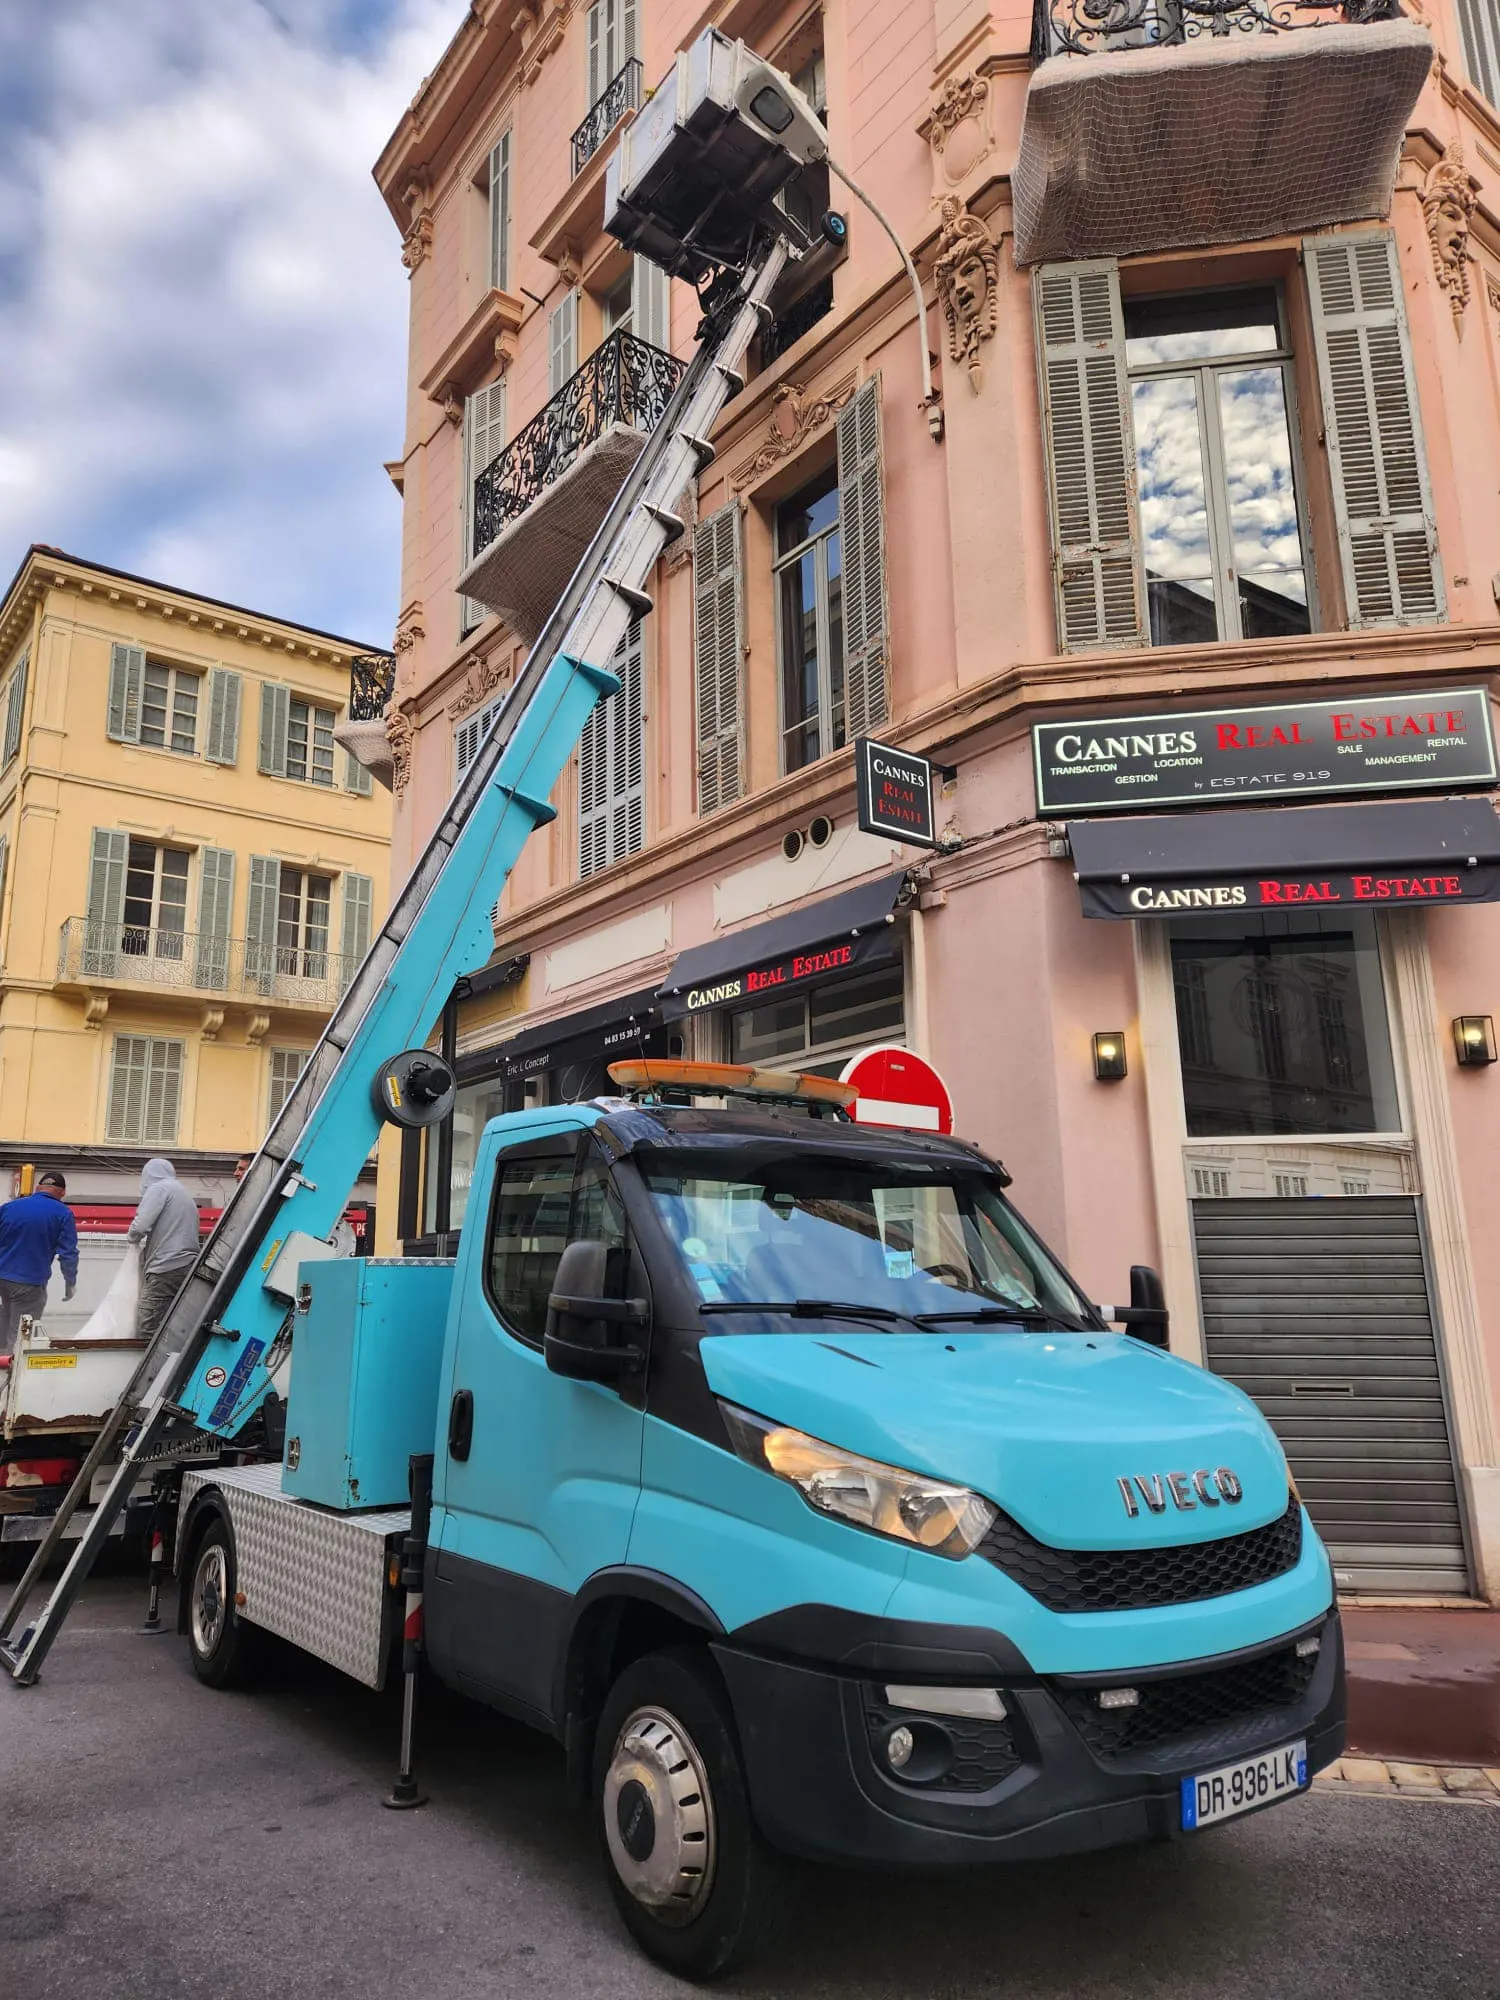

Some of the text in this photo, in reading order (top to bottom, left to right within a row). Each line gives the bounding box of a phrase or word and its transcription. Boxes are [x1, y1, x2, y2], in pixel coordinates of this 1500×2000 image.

[1055, 710, 1467, 762] CANNES REAL ESTATE
[1427, 737, 1467, 748] RENTAL
[1337, 744, 1363, 754] SALE
[1365, 753, 1437, 766] MANAGEMENT
[873, 759, 925, 787] CANNES
[1050, 763, 1118, 775] TRANSACTION
[1154, 757, 1203, 768] LOCATION
[1115, 774, 1158, 785] GESTION
[1194, 770, 1331, 790] by ESTATE 919
[883, 781, 915, 803] REAL
[878, 799, 923, 825] ESTATE
[1131, 876, 1462, 909] CANNES REAL ESTATE
[687, 946, 852, 1009] CANNES REAL ESTATE
[525, 1053, 550, 1070] Concept
[1117, 1467, 1243, 1518] IVECO
[1198, 1750, 1296, 1818] DR-936-LK
